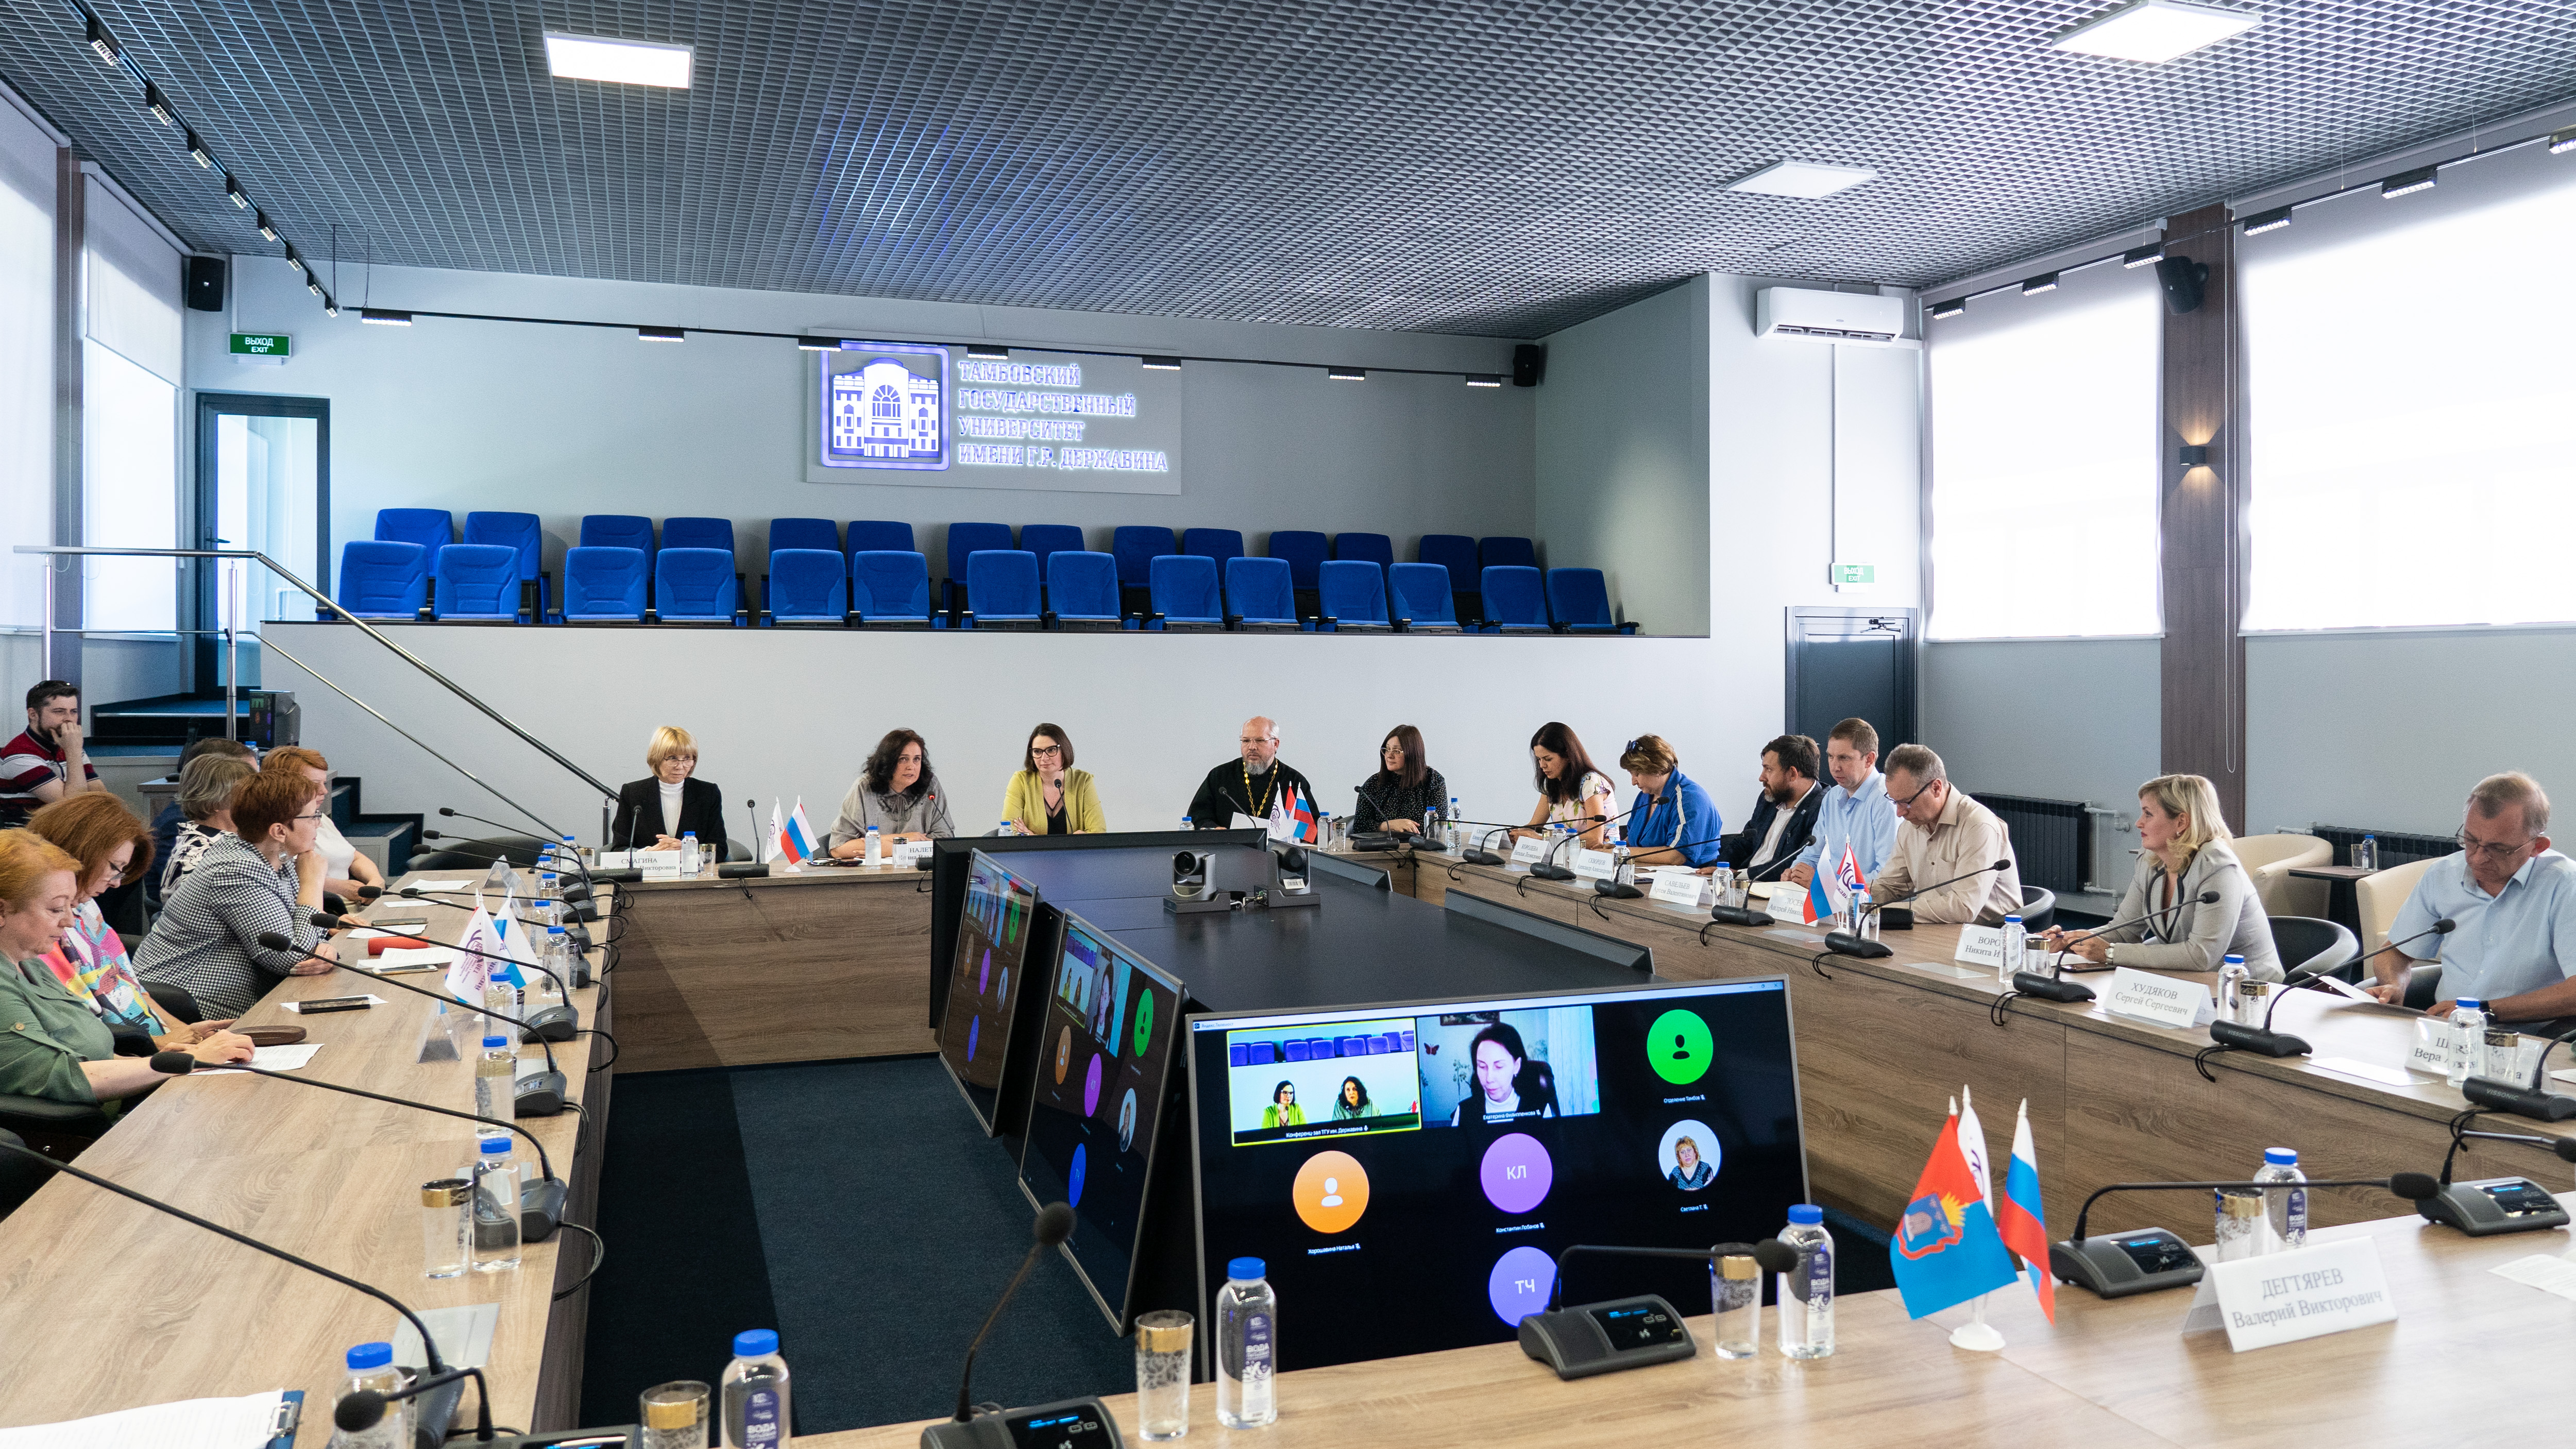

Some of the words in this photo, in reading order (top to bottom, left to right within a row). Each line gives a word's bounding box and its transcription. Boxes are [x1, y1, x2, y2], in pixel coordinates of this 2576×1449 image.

[245, 337, 274, 347] ВЫХОД
[958, 361, 1081, 387] ТАМБОВСКИЙ
[958, 389, 1136, 417] ГОСУДАРСТВЕННЫЙ
[958, 416, 1085, 440] УНИВЕРСИТЕТ
[958, 445, 1024, 465] ИМЕНИ
[1028, 447, 1057, 467] Г.Р.
[1060, 448, 1168, 471] ДЕРЖАВИНА
[1843, 567, 1864, 576] ВЫХОД
[1665, 880, 1690, 890] САВЕЛЬЕВ
[1667, 889, 1697, 899] Валентинович
[1769, 904, 1787, 913] Андрей
[1787, 907, 1804, 916] Никол
[1978, 936, 2001, 946] ВОРО
[1965, 945, 1992, 956] Никита
[2130, 982, 2178, 1000] ХУДЯКОВ
[2115, 991, 2144, 1006] Сергей
[2145, 998, 2188, 1015] Сергеевич
[2227, 1029, 2252, 1039] VISSONIC
[2414, 1048, 2442, 1062] Вера
[2486, 1088, 2520, 1101] VISSONIC
[1286, 1130, 1321, 1138] Конференц-зал
[1506, 1164, 1528, 1180] КЛ
[1308, 1247, 1336, 1255] Хорошавина
[1515, 1278, 1535, 1294] ТЧ
[2262, 1268, 2345, 1300] ДЕГТЯРЕВ
[2232, 1303, 2296, 1329] Валерий
[2300, 1289, 2384, 1318] Викторович
[747, 1422, 777, 1434] ВОДА
